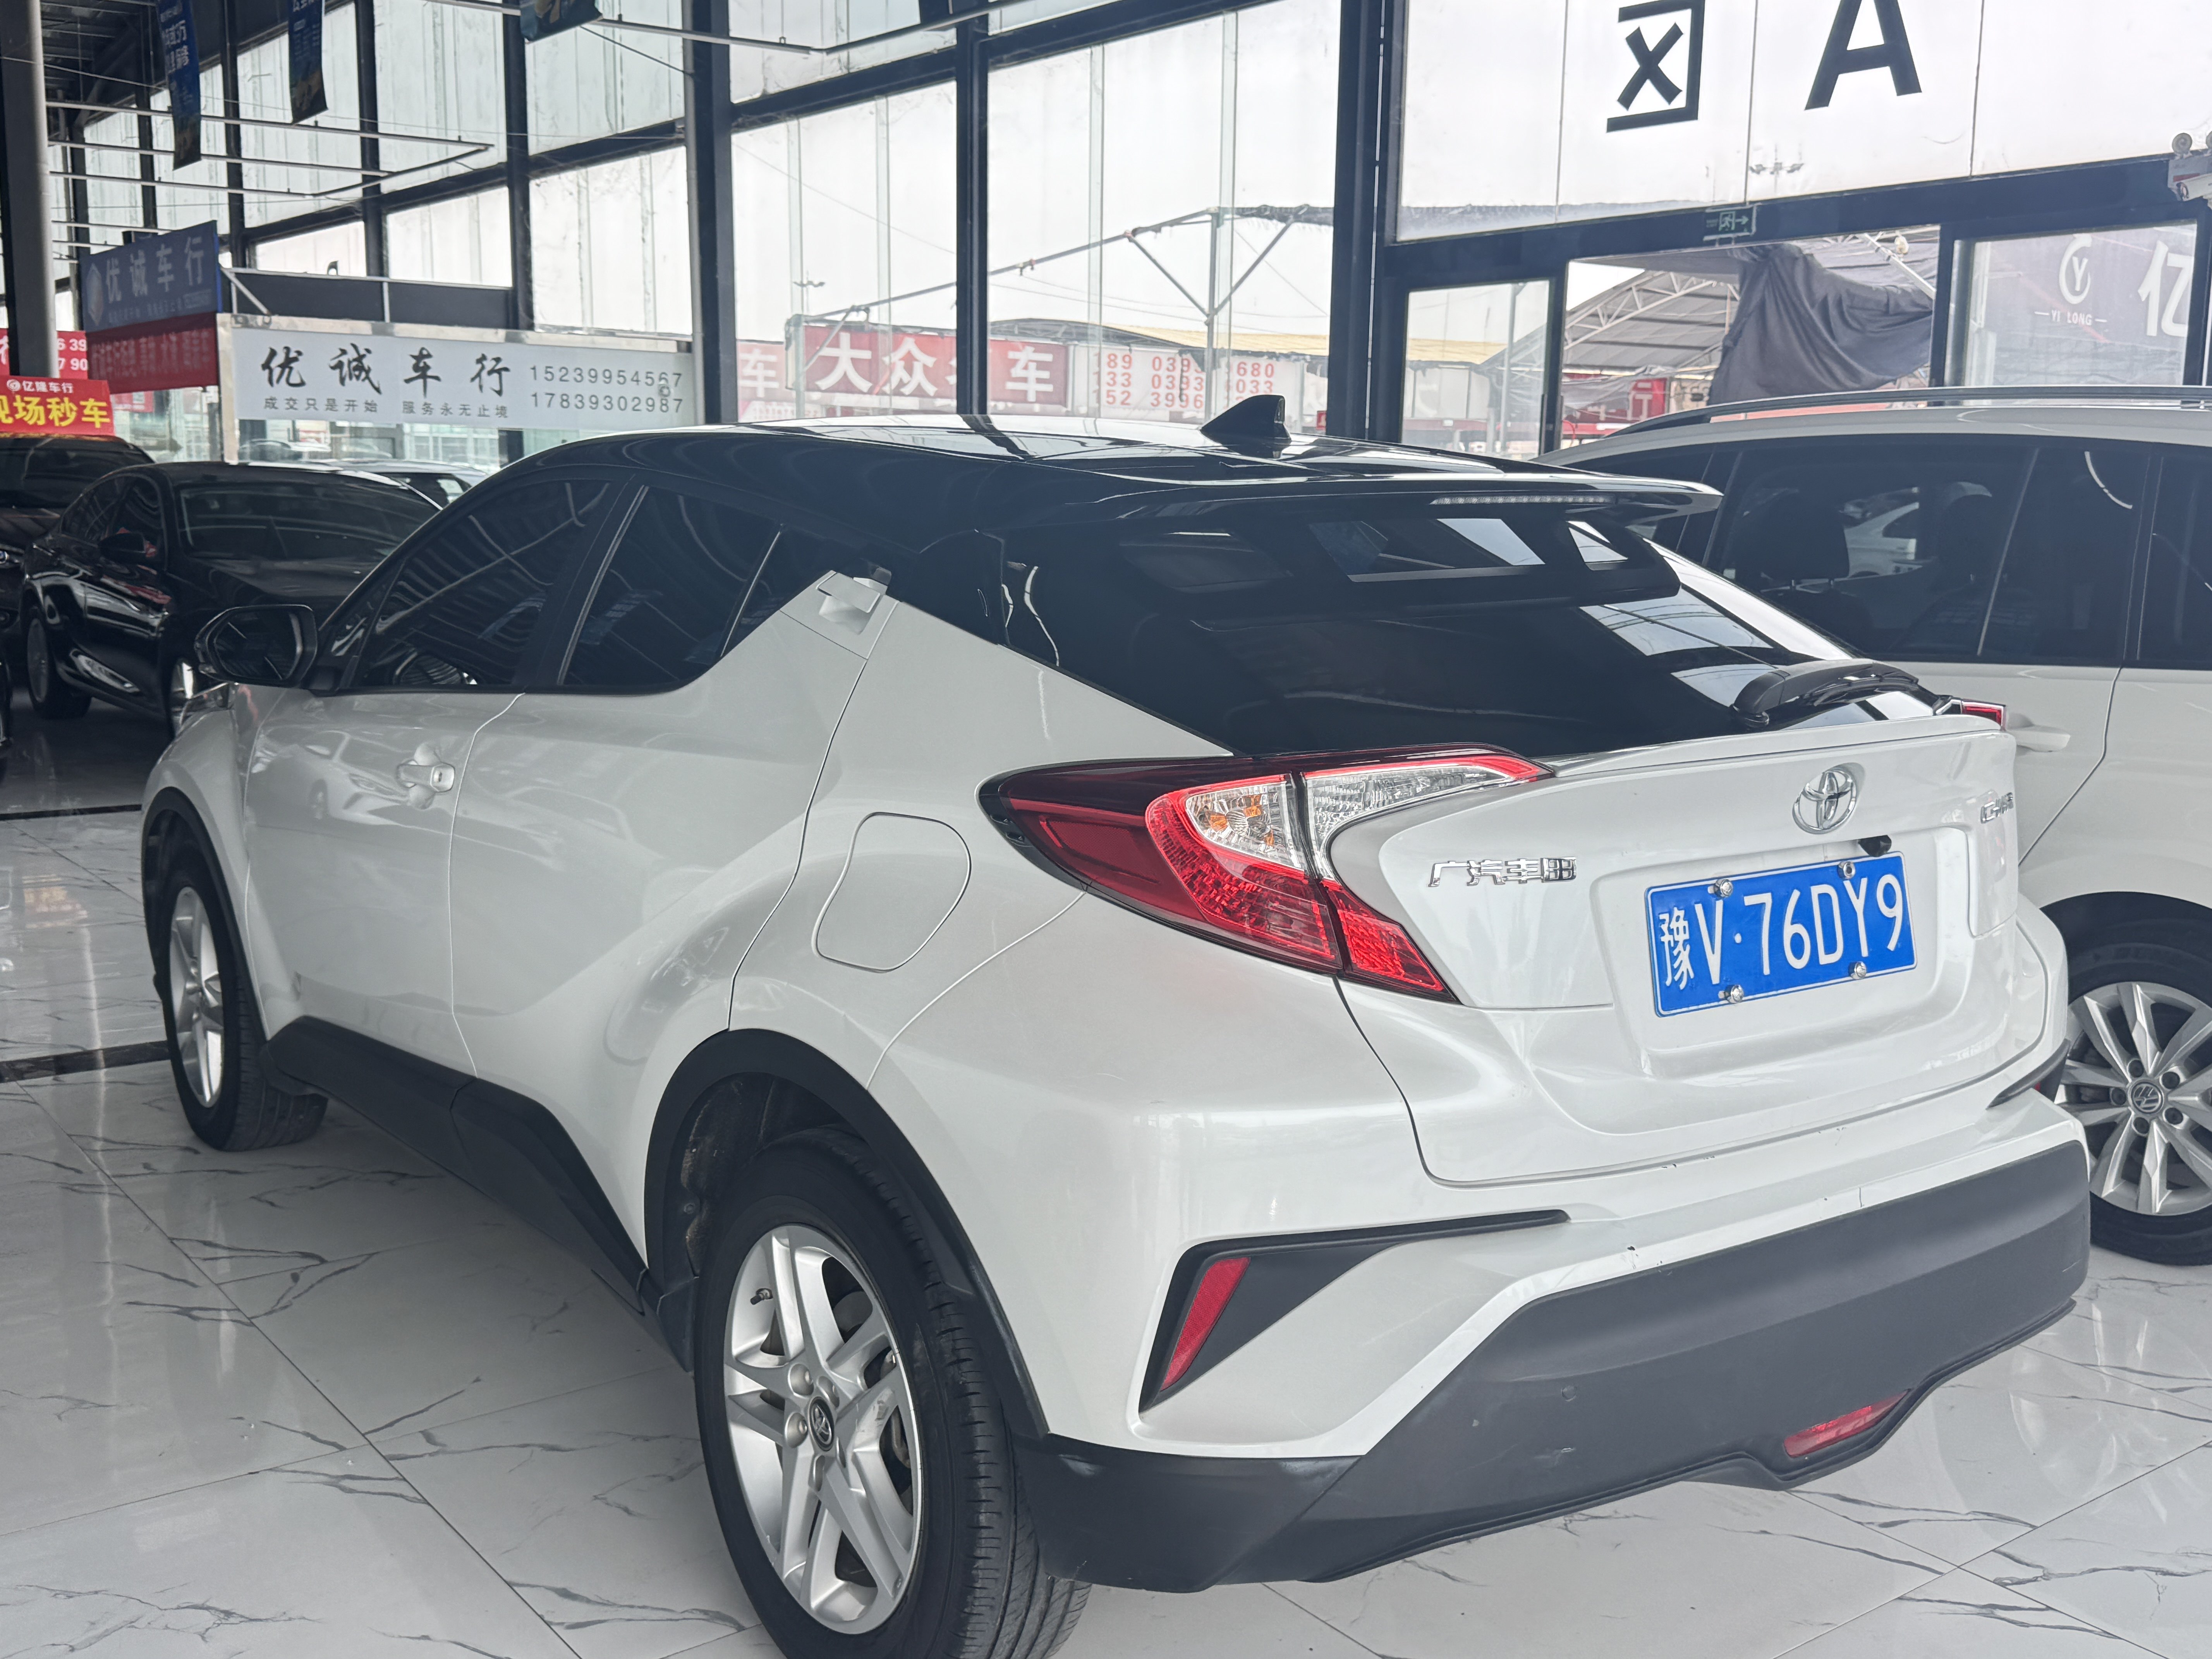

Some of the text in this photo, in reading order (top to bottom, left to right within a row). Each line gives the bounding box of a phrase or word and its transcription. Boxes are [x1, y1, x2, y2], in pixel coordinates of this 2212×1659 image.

[2052, 310, 2092, 326] YI LONG
[261, 343, 510, 398] 优诚车行
[530, 365, 682, 387] 15239954567
[22, 381, 73, 393] 亿隆车行
[264, 396, 508, 418] 成交只是开始 服务永无止境
[531, 392, 683, 413] 17839302987
[1427, 856, 1577, 887] 广汽丰田
